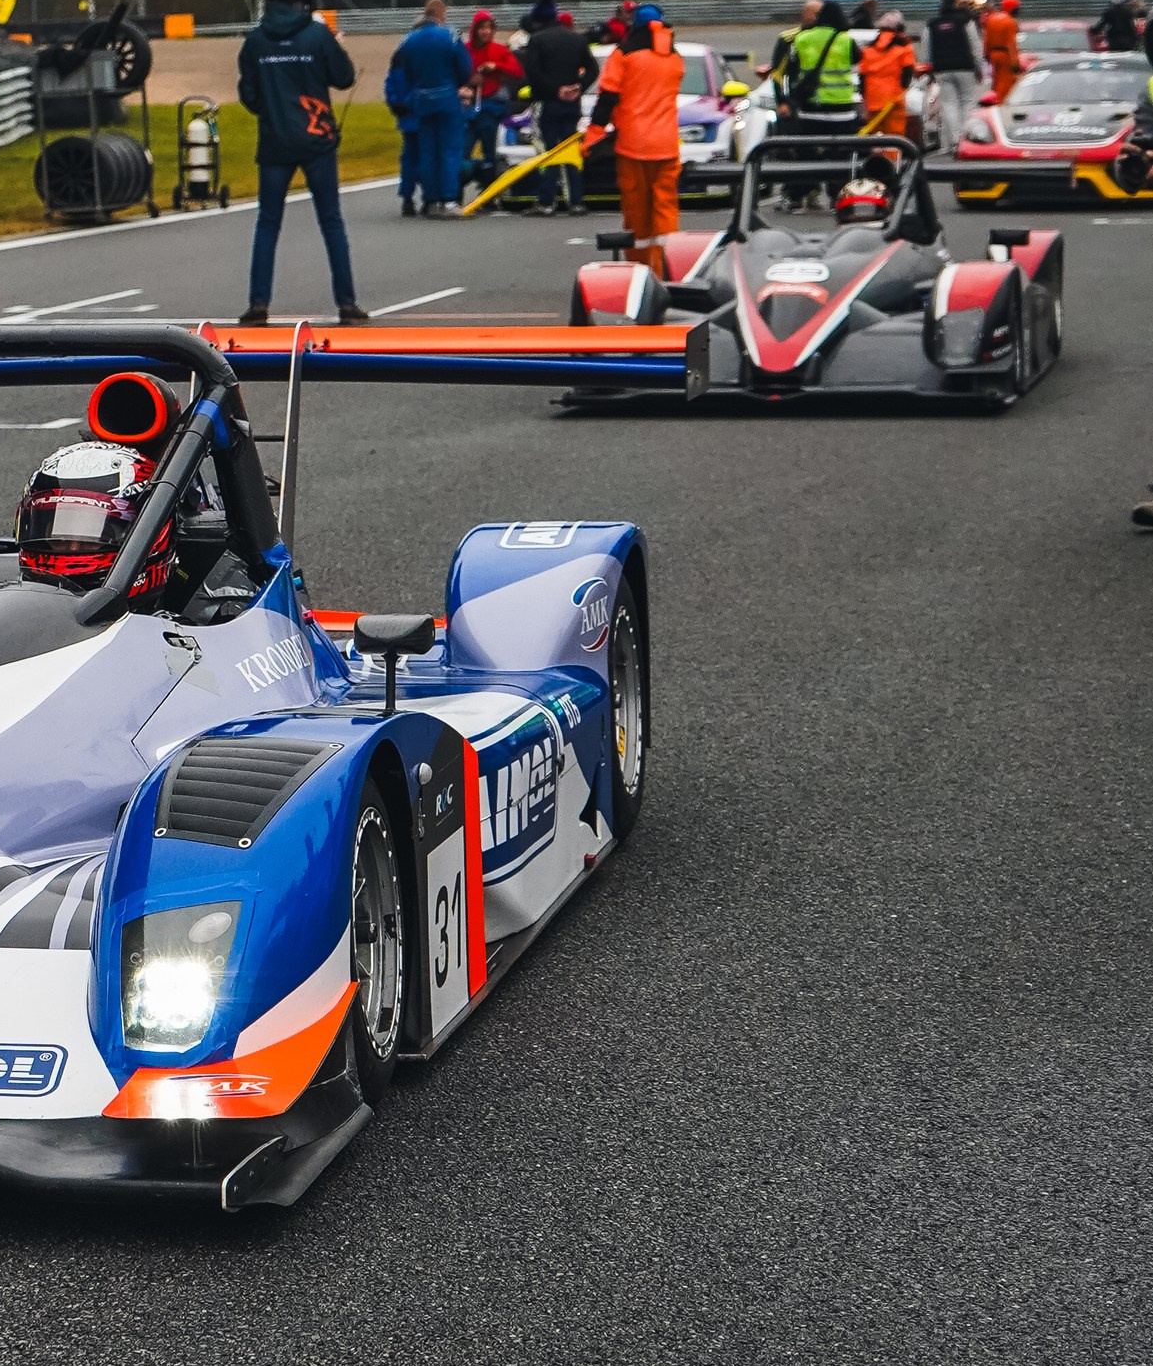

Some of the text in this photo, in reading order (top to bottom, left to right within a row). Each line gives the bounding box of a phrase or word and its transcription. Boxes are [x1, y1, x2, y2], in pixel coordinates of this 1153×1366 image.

[580, 594, 609, 635] AMK
[235, 634, 311, 694] KRONDEL
[434, 870, 462, 989] 31
